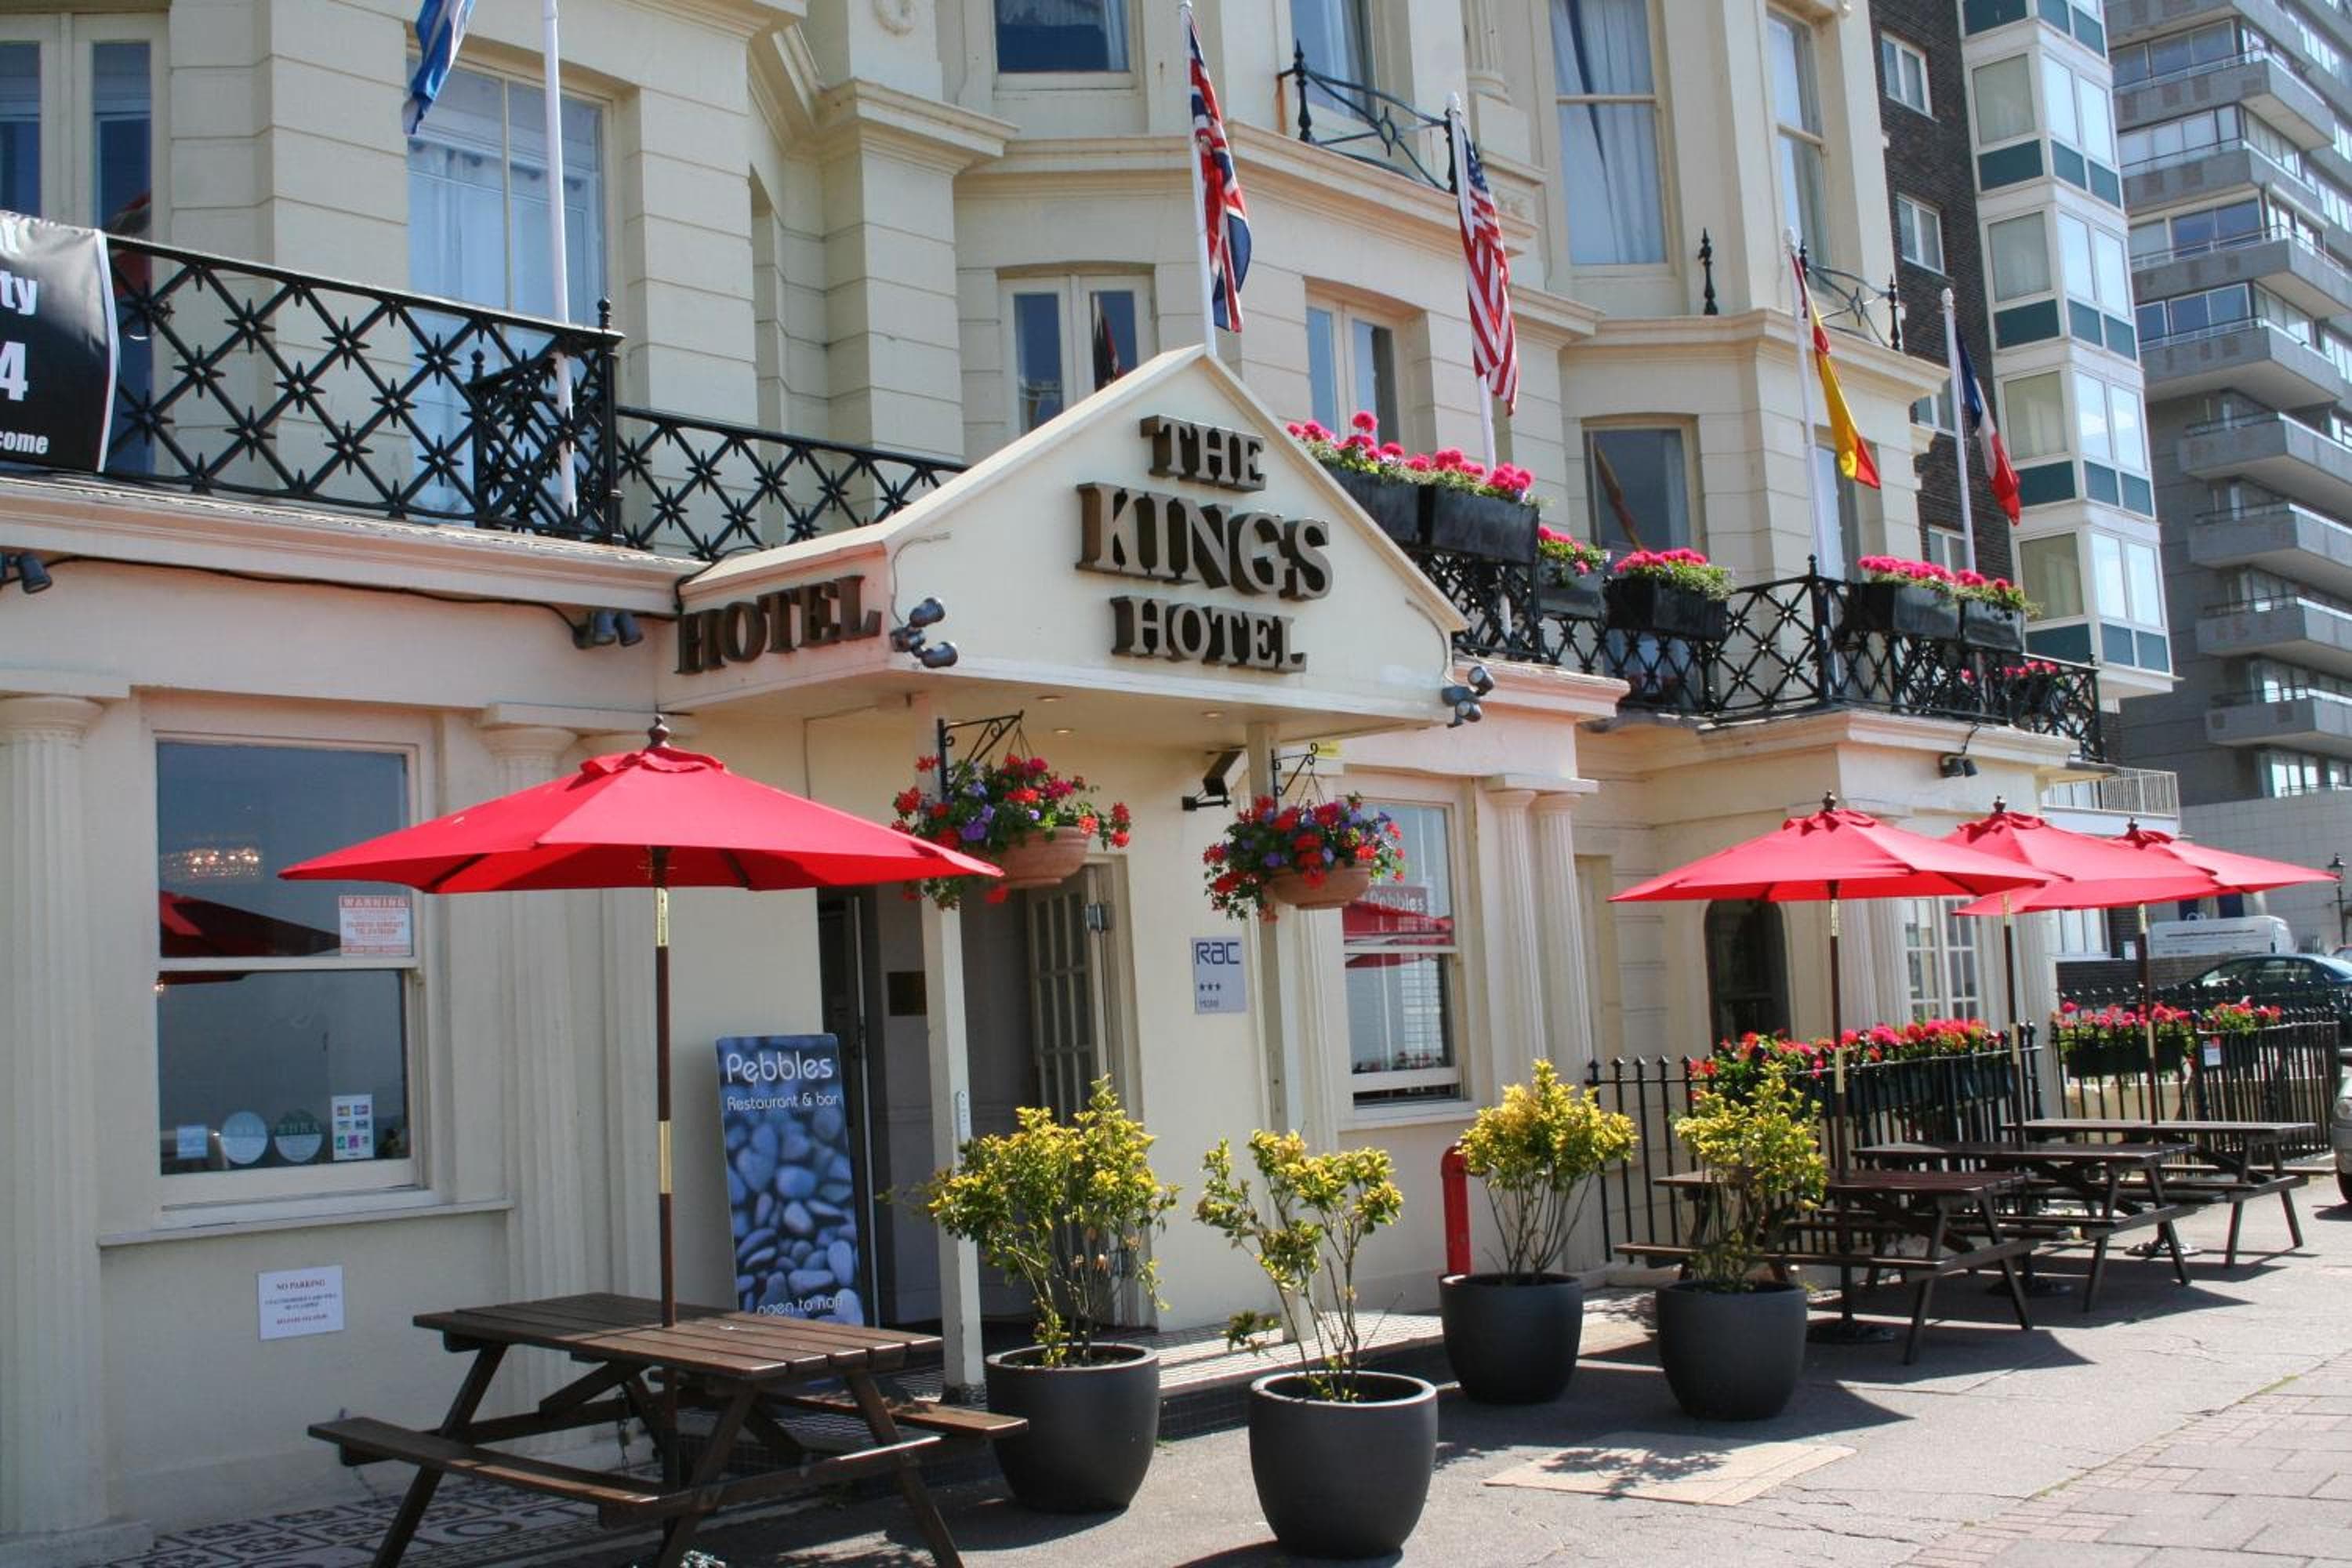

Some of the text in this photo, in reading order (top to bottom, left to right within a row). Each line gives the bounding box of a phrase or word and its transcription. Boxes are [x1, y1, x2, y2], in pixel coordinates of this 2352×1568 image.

[1141, 415, 1266, 492] THE
[1076, 481, 1333, 601] KINGS
[676, 575, 883, 673] HOTEL
[1110, 596, 1306, 672] HOTEL
[727, 1051, 833, 1087] Pebbles
[727, 1091, 840, 1111] Restaurant & bar
[798, 1298, 813, 1312] to
